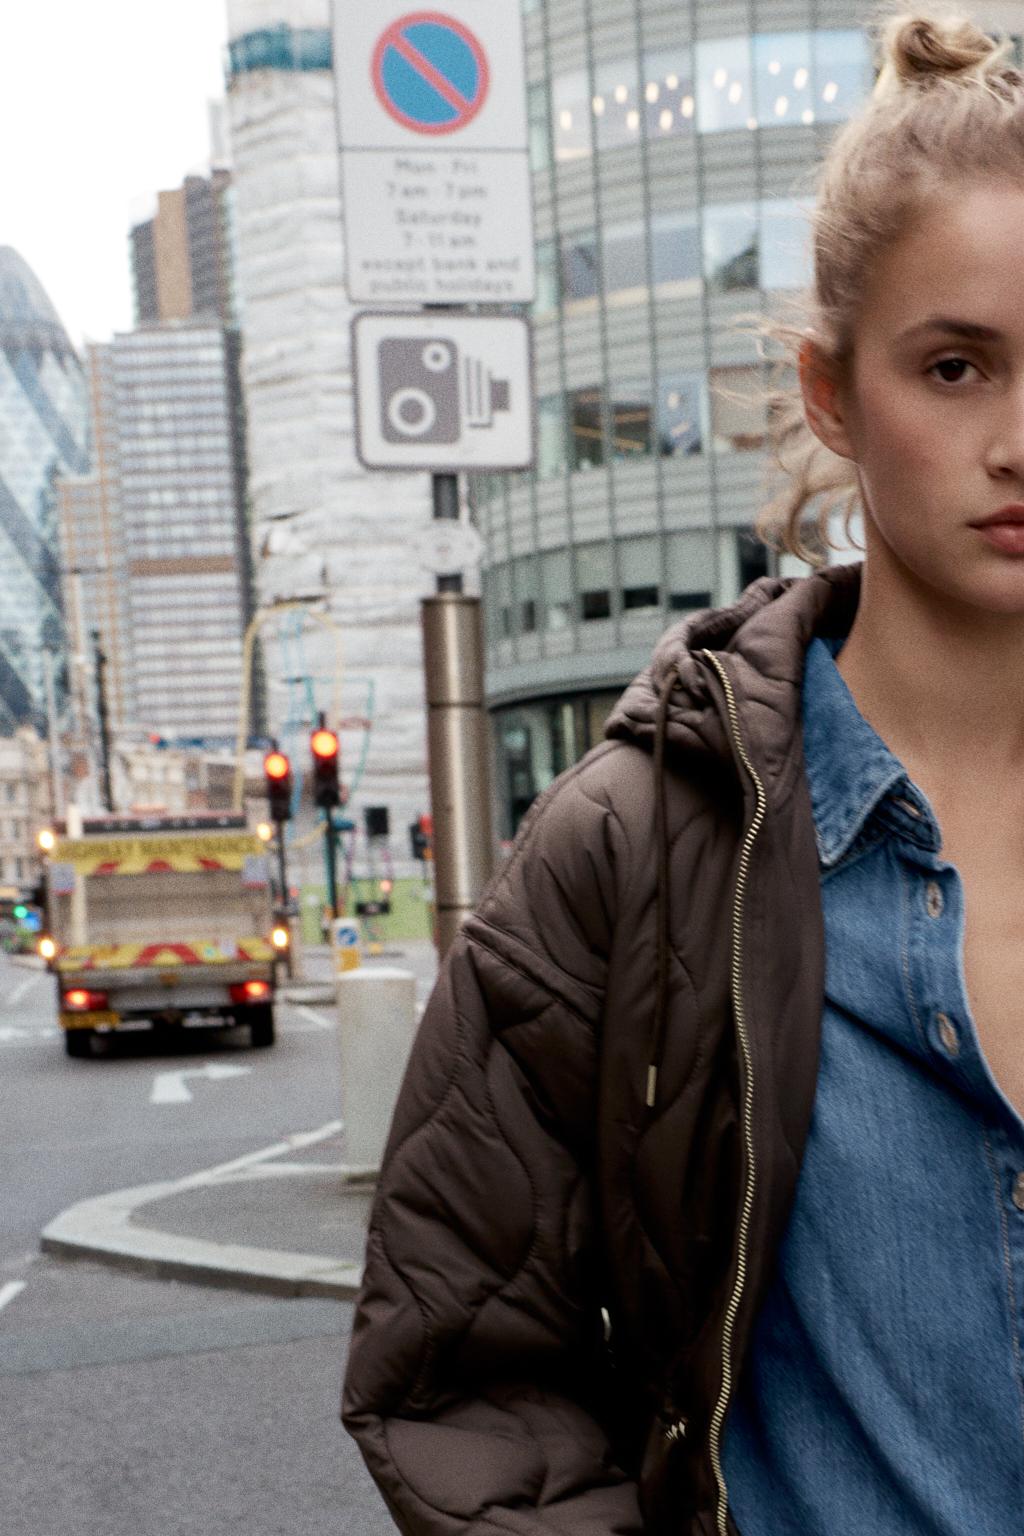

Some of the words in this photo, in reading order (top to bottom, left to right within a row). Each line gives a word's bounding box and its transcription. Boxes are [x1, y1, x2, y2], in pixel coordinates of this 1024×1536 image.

[394, 158, 436, 174] Mon
[451, 158, 478, 174] Fri
[386, 180, 397, 198] 7
[395, 207, 482, 228] Saturday
[449, 236, 476, 248] am
[361, 257, 424, 275] except
[431, 257, 477, 272] bank
[486, 255, 520, 272] and
[369, 279, 427, 295] public
[434, 278, 514, 295] holidays
